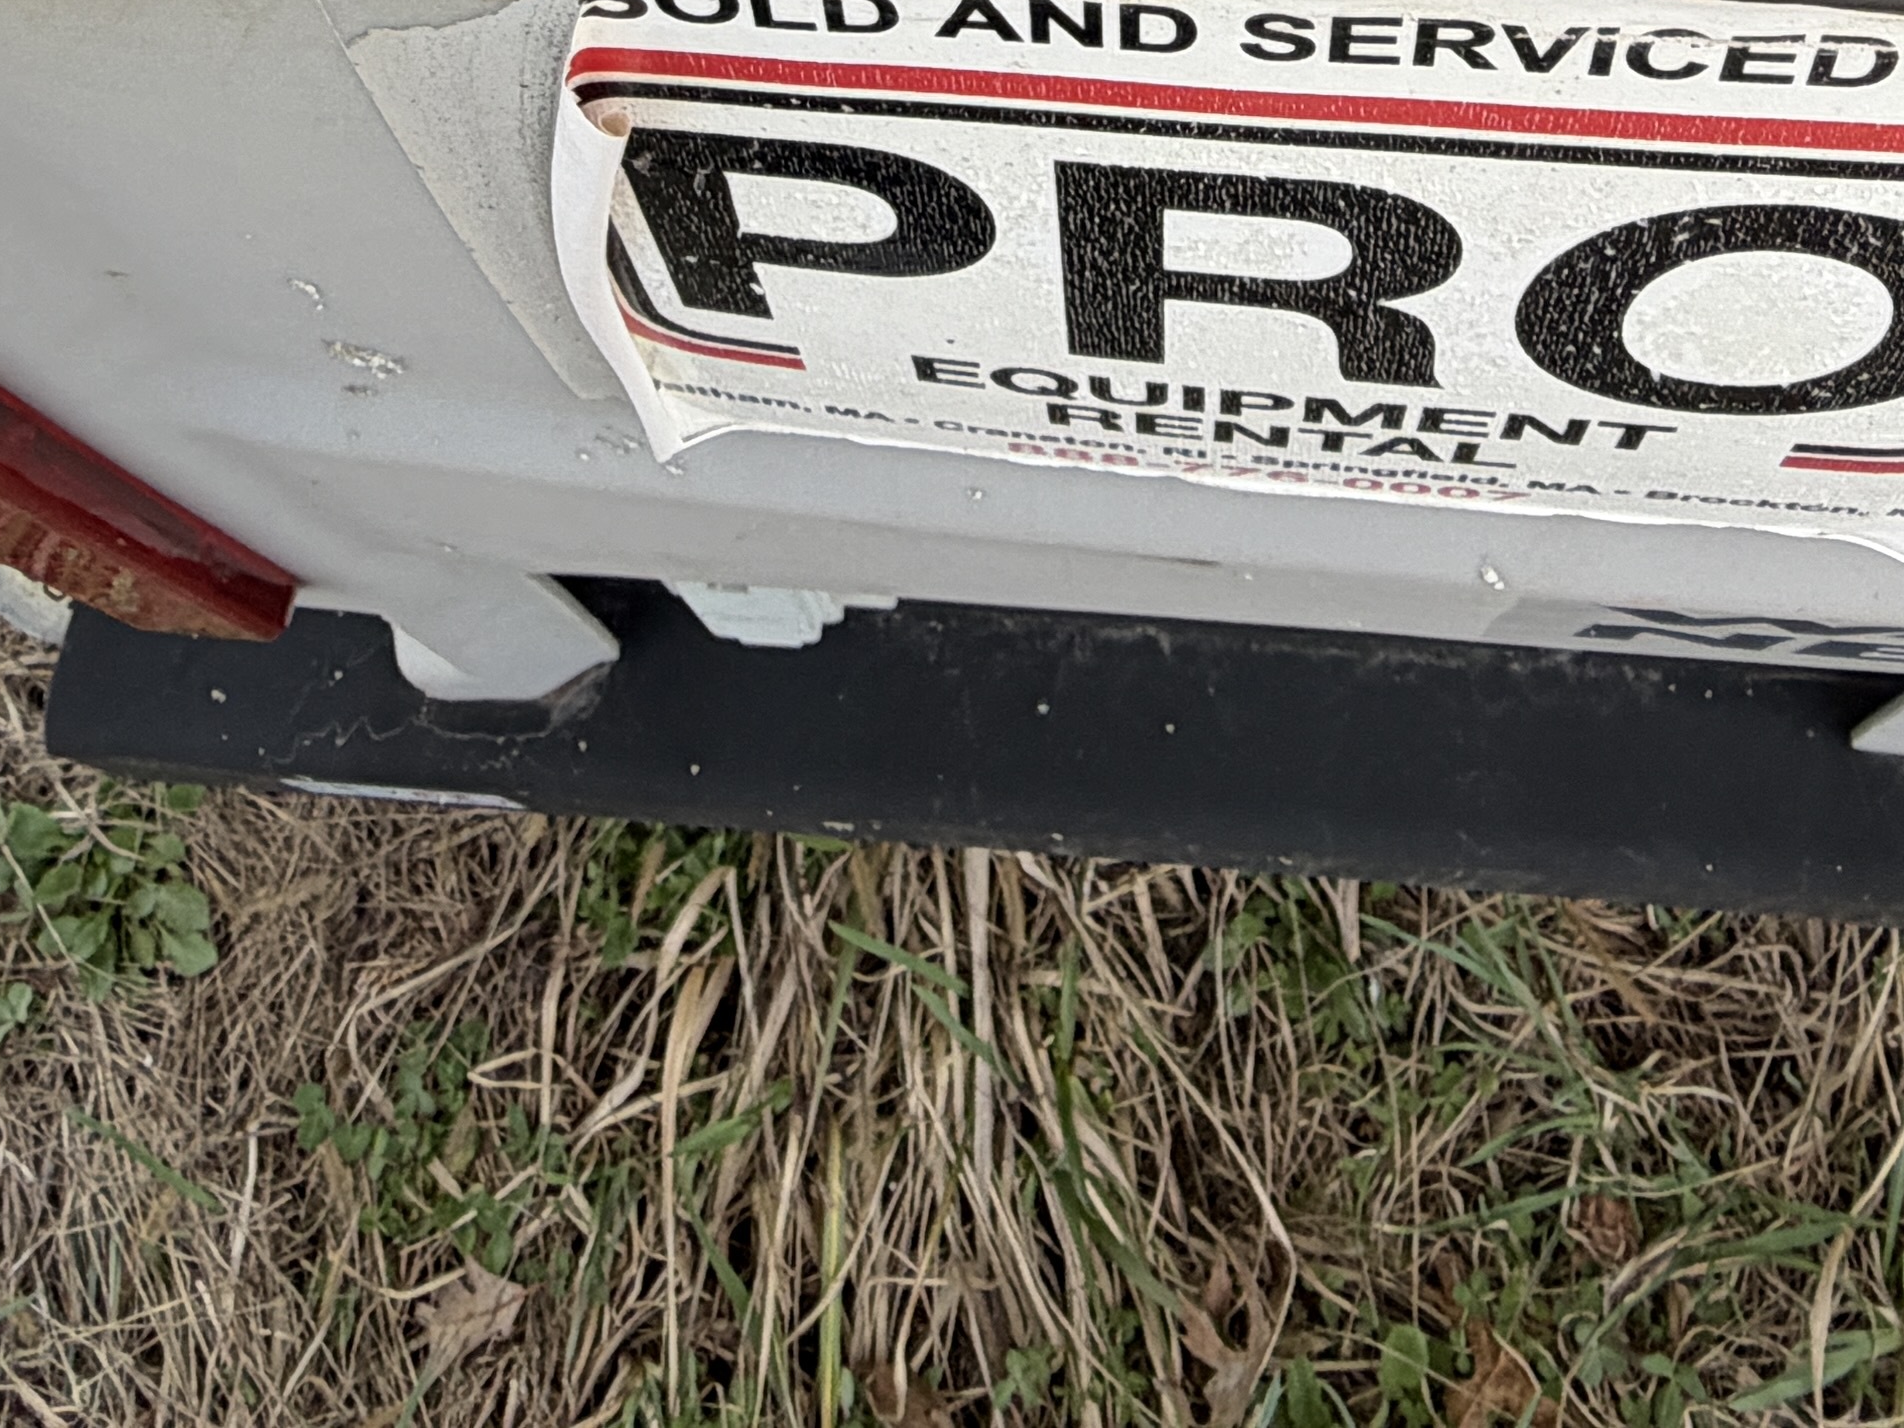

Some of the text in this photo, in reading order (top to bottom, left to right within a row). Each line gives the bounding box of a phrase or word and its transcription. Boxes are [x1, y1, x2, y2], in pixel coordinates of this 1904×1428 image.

[1239, 12, 1900, 89] SERVICED
[652, 378, 812, 413] altham,
[824, 404, 896, 424] MA
[1250, 454, 1510, 488] Springfield,
[1526, 479, 1601, 495] MA
[911, 354, 1679, 451] EQUIPMENT
[1047, 403, 1518, 469] RENTAL
